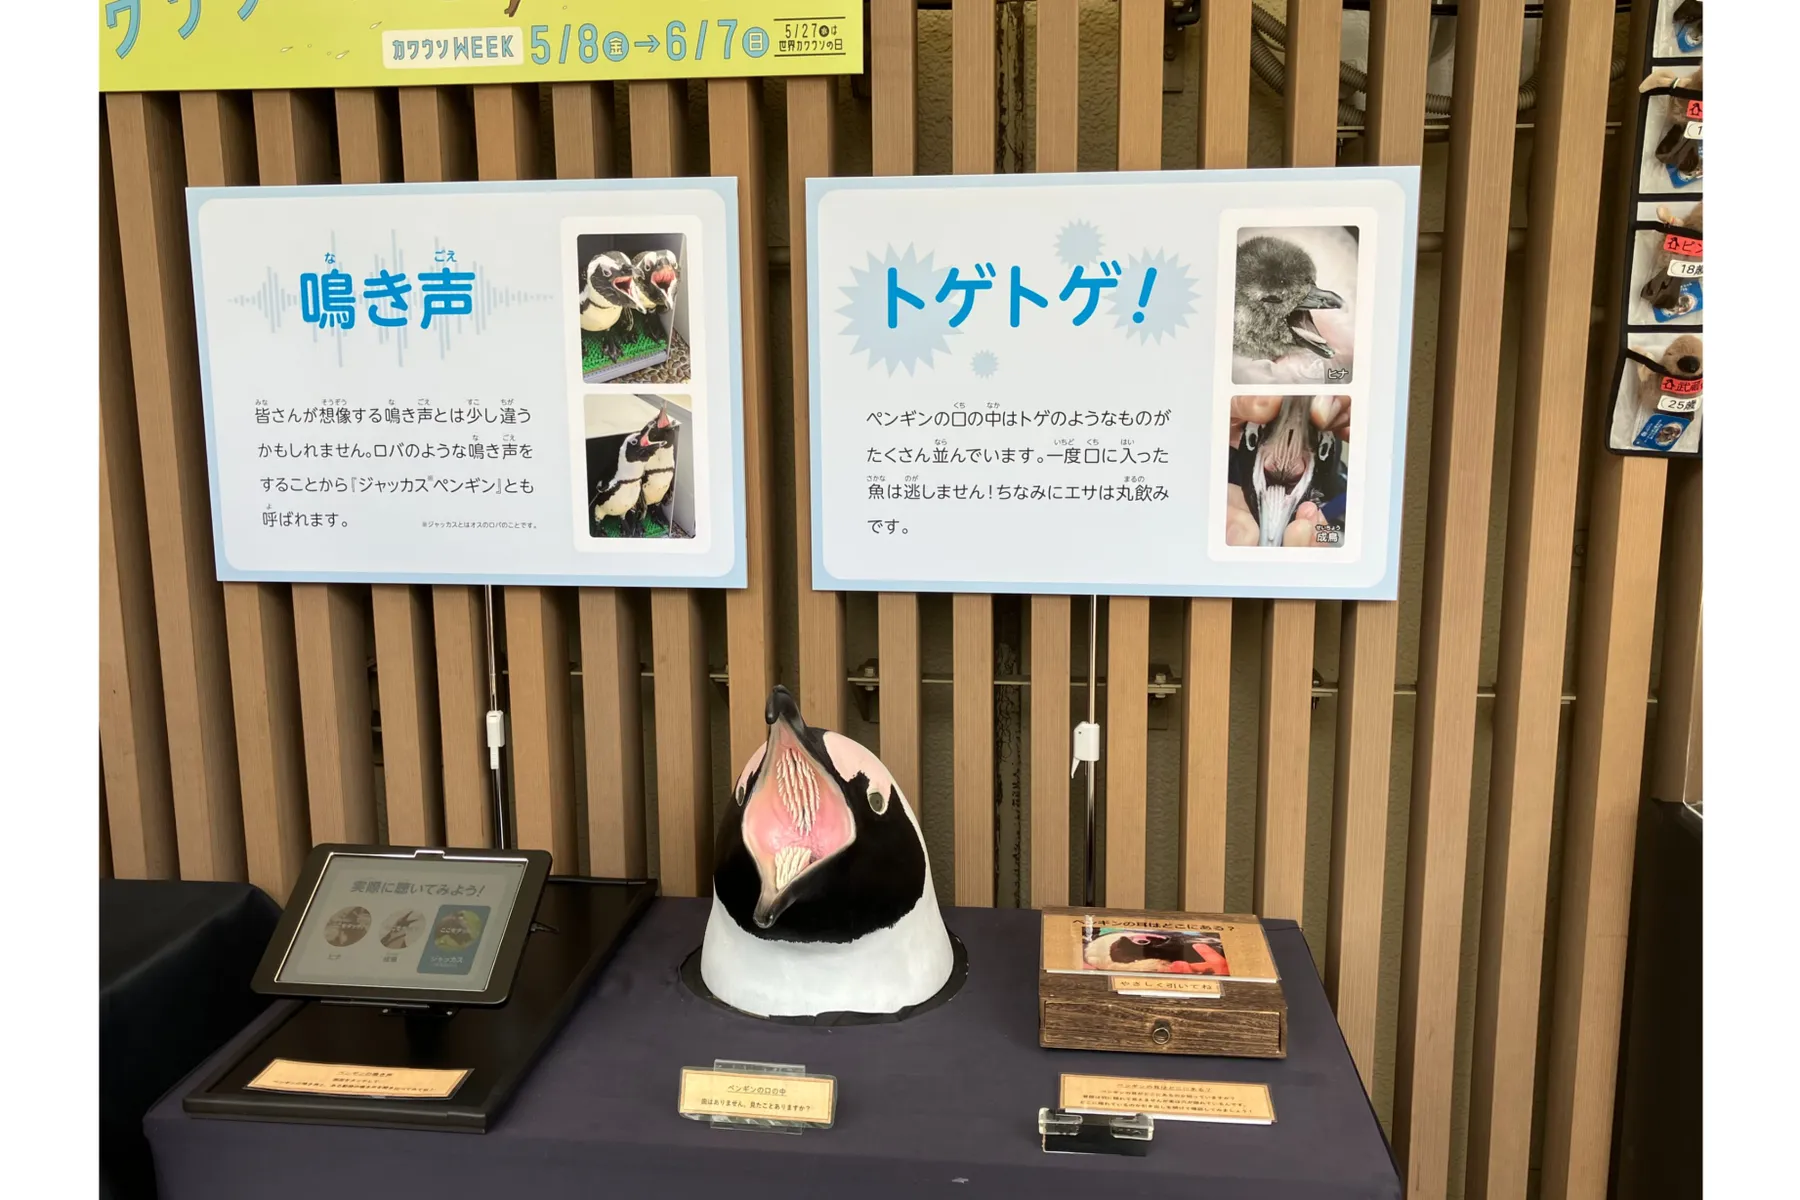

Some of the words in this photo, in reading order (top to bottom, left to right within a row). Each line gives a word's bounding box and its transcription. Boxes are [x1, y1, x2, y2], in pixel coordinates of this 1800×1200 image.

[779, 38, 843, 52] 世界カワウソの日
[324, 252, 336, 264] な
[434, 250, 457, 263] ごえ
[299, 266, 476, 330] 鳴き声
[887, 259, 1158, 329] トゲトゲ！
[417, 398, 431, 406] ごえ
[467, 398, 480, 406] すこ
[254, 406, 532, 425] 皆さんが想像する鳴き声とは少し違う
[866, 408, 1172, 428] ペンギンの口の中はトゲのようなものが
[472, 434, 479, 442] な
[502, 434, 516, 442] ごえ
[934, 438, 948, 446] なら
[1053, 438, 1075, 446] いちど
[1086, 438, 1099, 446] くち
[1120, 438, 1135, 446] はい
[257, 442, 534, 460] かもしれません。ロバのような鳴き声を
[866, 446, 1169, 464] たくさん並んでいます。一度口に入った
[866, 475, 886, 483] さかな
[1123, 475, 1145, 483] まるの
[867, 484, 1170, 502] 魚は逃しません！ちなみにエサは丸飲み
[262, 511, 348, 528] 呼ばれます。
[866, 518, 909, 535] です。
[727, 1084, 787, 1095] ペンギンの口の中
